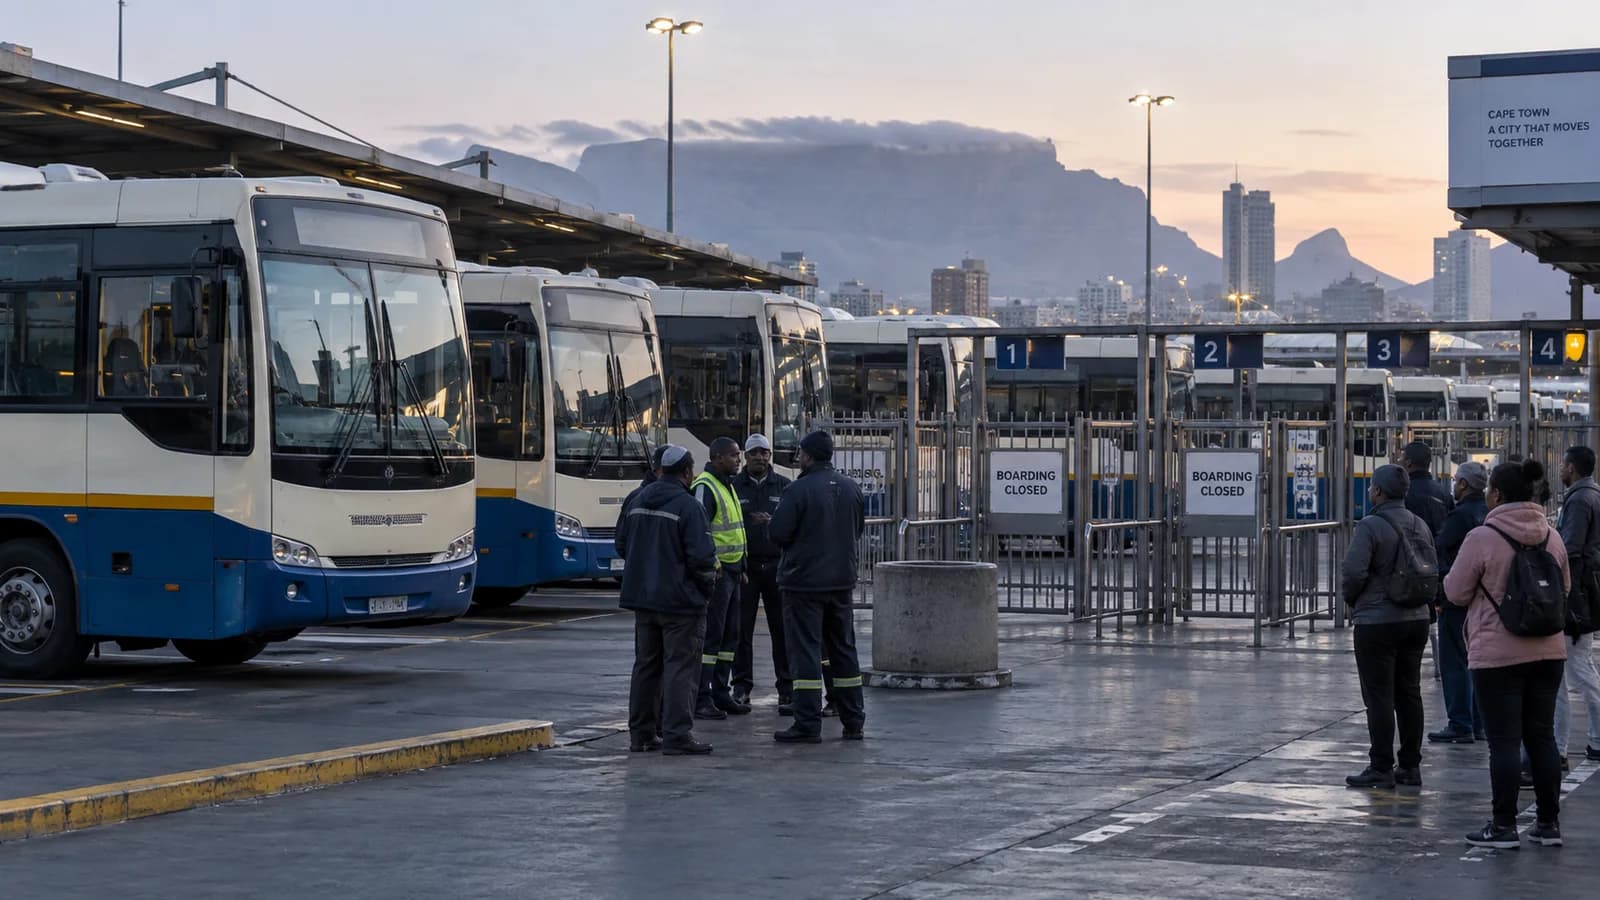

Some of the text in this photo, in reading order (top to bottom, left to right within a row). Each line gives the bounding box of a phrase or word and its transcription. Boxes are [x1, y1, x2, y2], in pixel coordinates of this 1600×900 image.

[1488, 108, 1550, 119] CAPE TOWN
[1488, 122, 1590, 135] A CITY THAT MOVES
[1488, 137, 1544, 149] TOGETHER
[1006, 343, 1016, 364] 1
[1203, 340, 1219, 363] 2
[1377, 339, 1392, 361] 3
[1540, 337, 1556, 360] 4
[996, 470, 1056, 481] BOARDING
[1192, 471, 1253, 481] BOARDING
[1004, 485, 1048, 495] CLOSED
[1200, 486, 1245, 496] CLOSED
